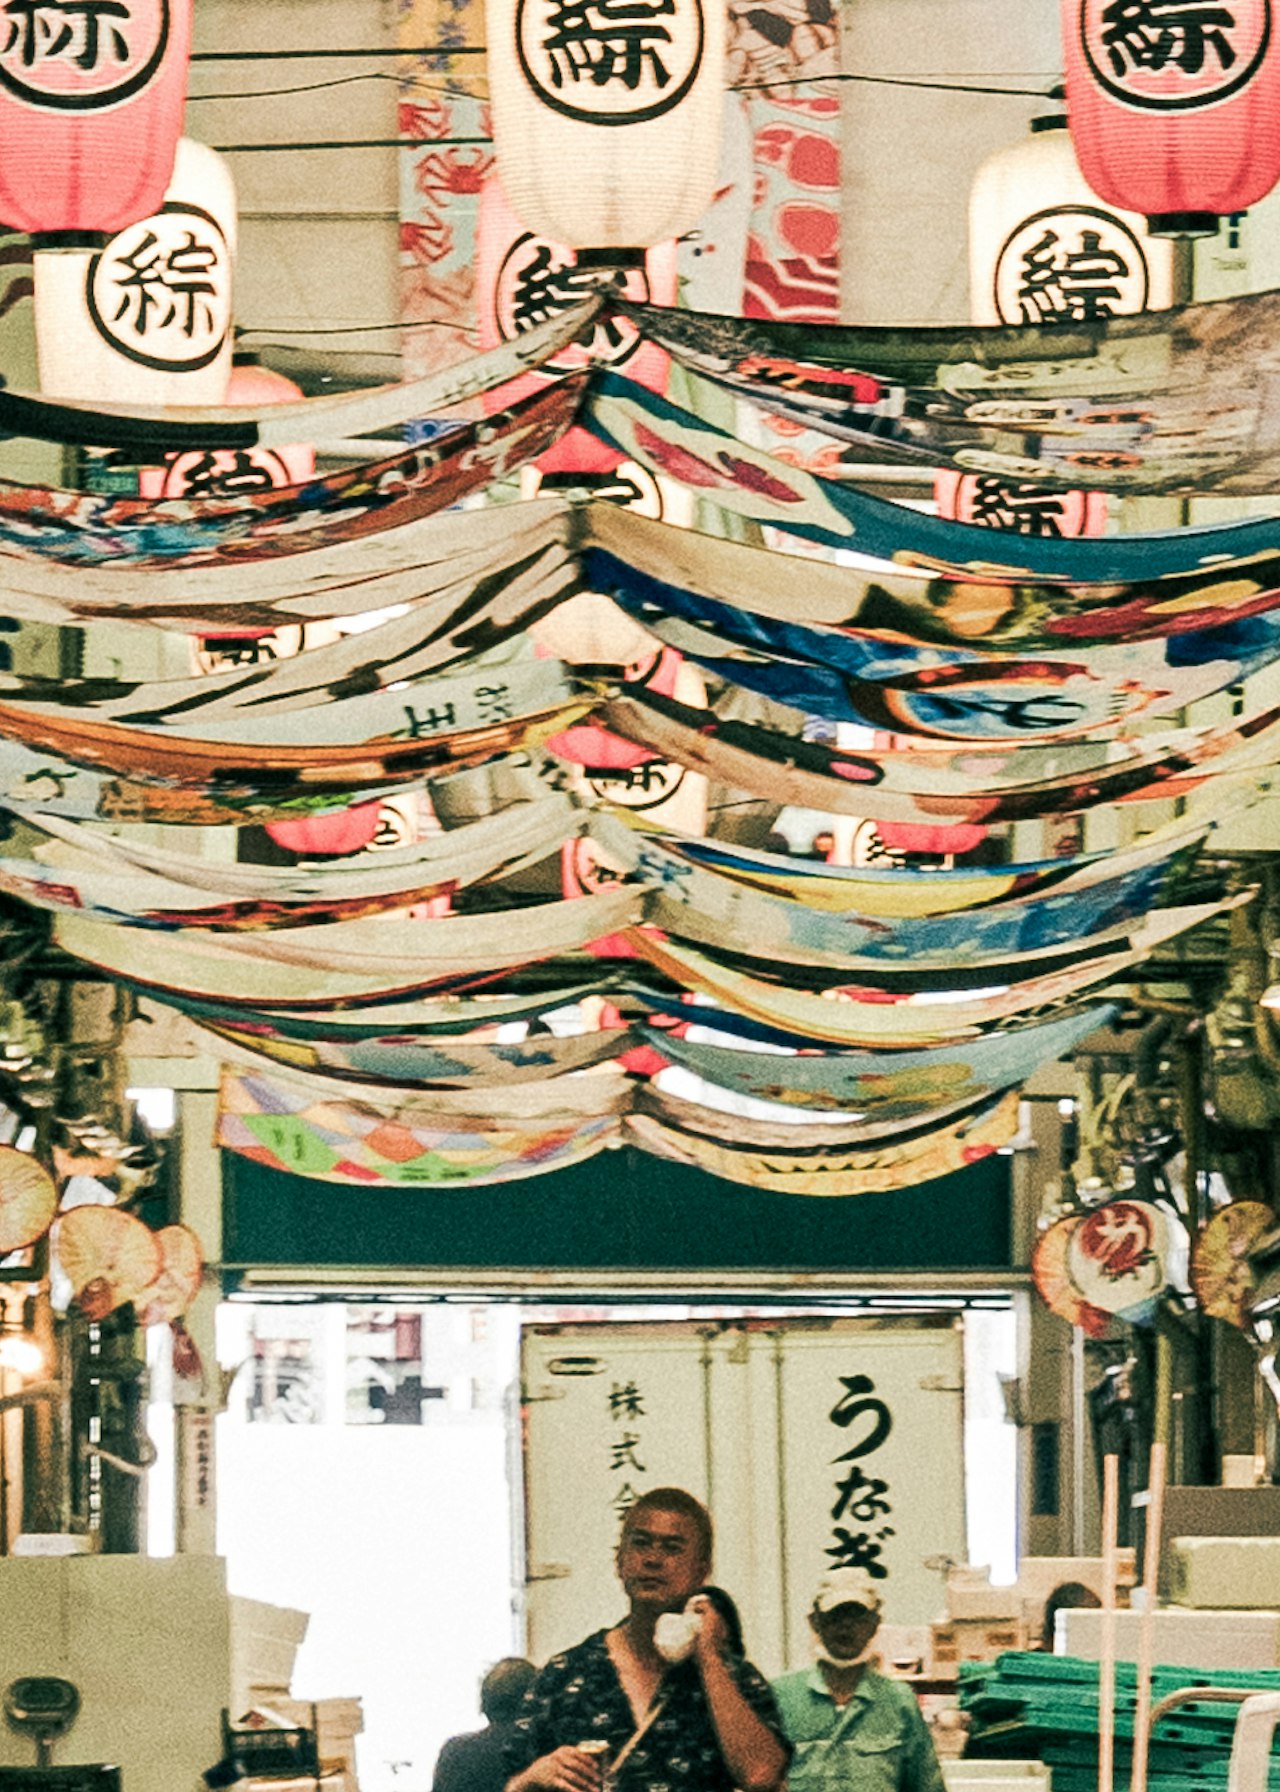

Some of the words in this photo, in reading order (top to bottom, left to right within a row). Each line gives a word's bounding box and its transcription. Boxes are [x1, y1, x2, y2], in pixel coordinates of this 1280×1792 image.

[112, 230, 218, 338] 綜
[608, 1382, 646, 1560] 株式会
[824, 1374, 895, 1579] うなぎ
